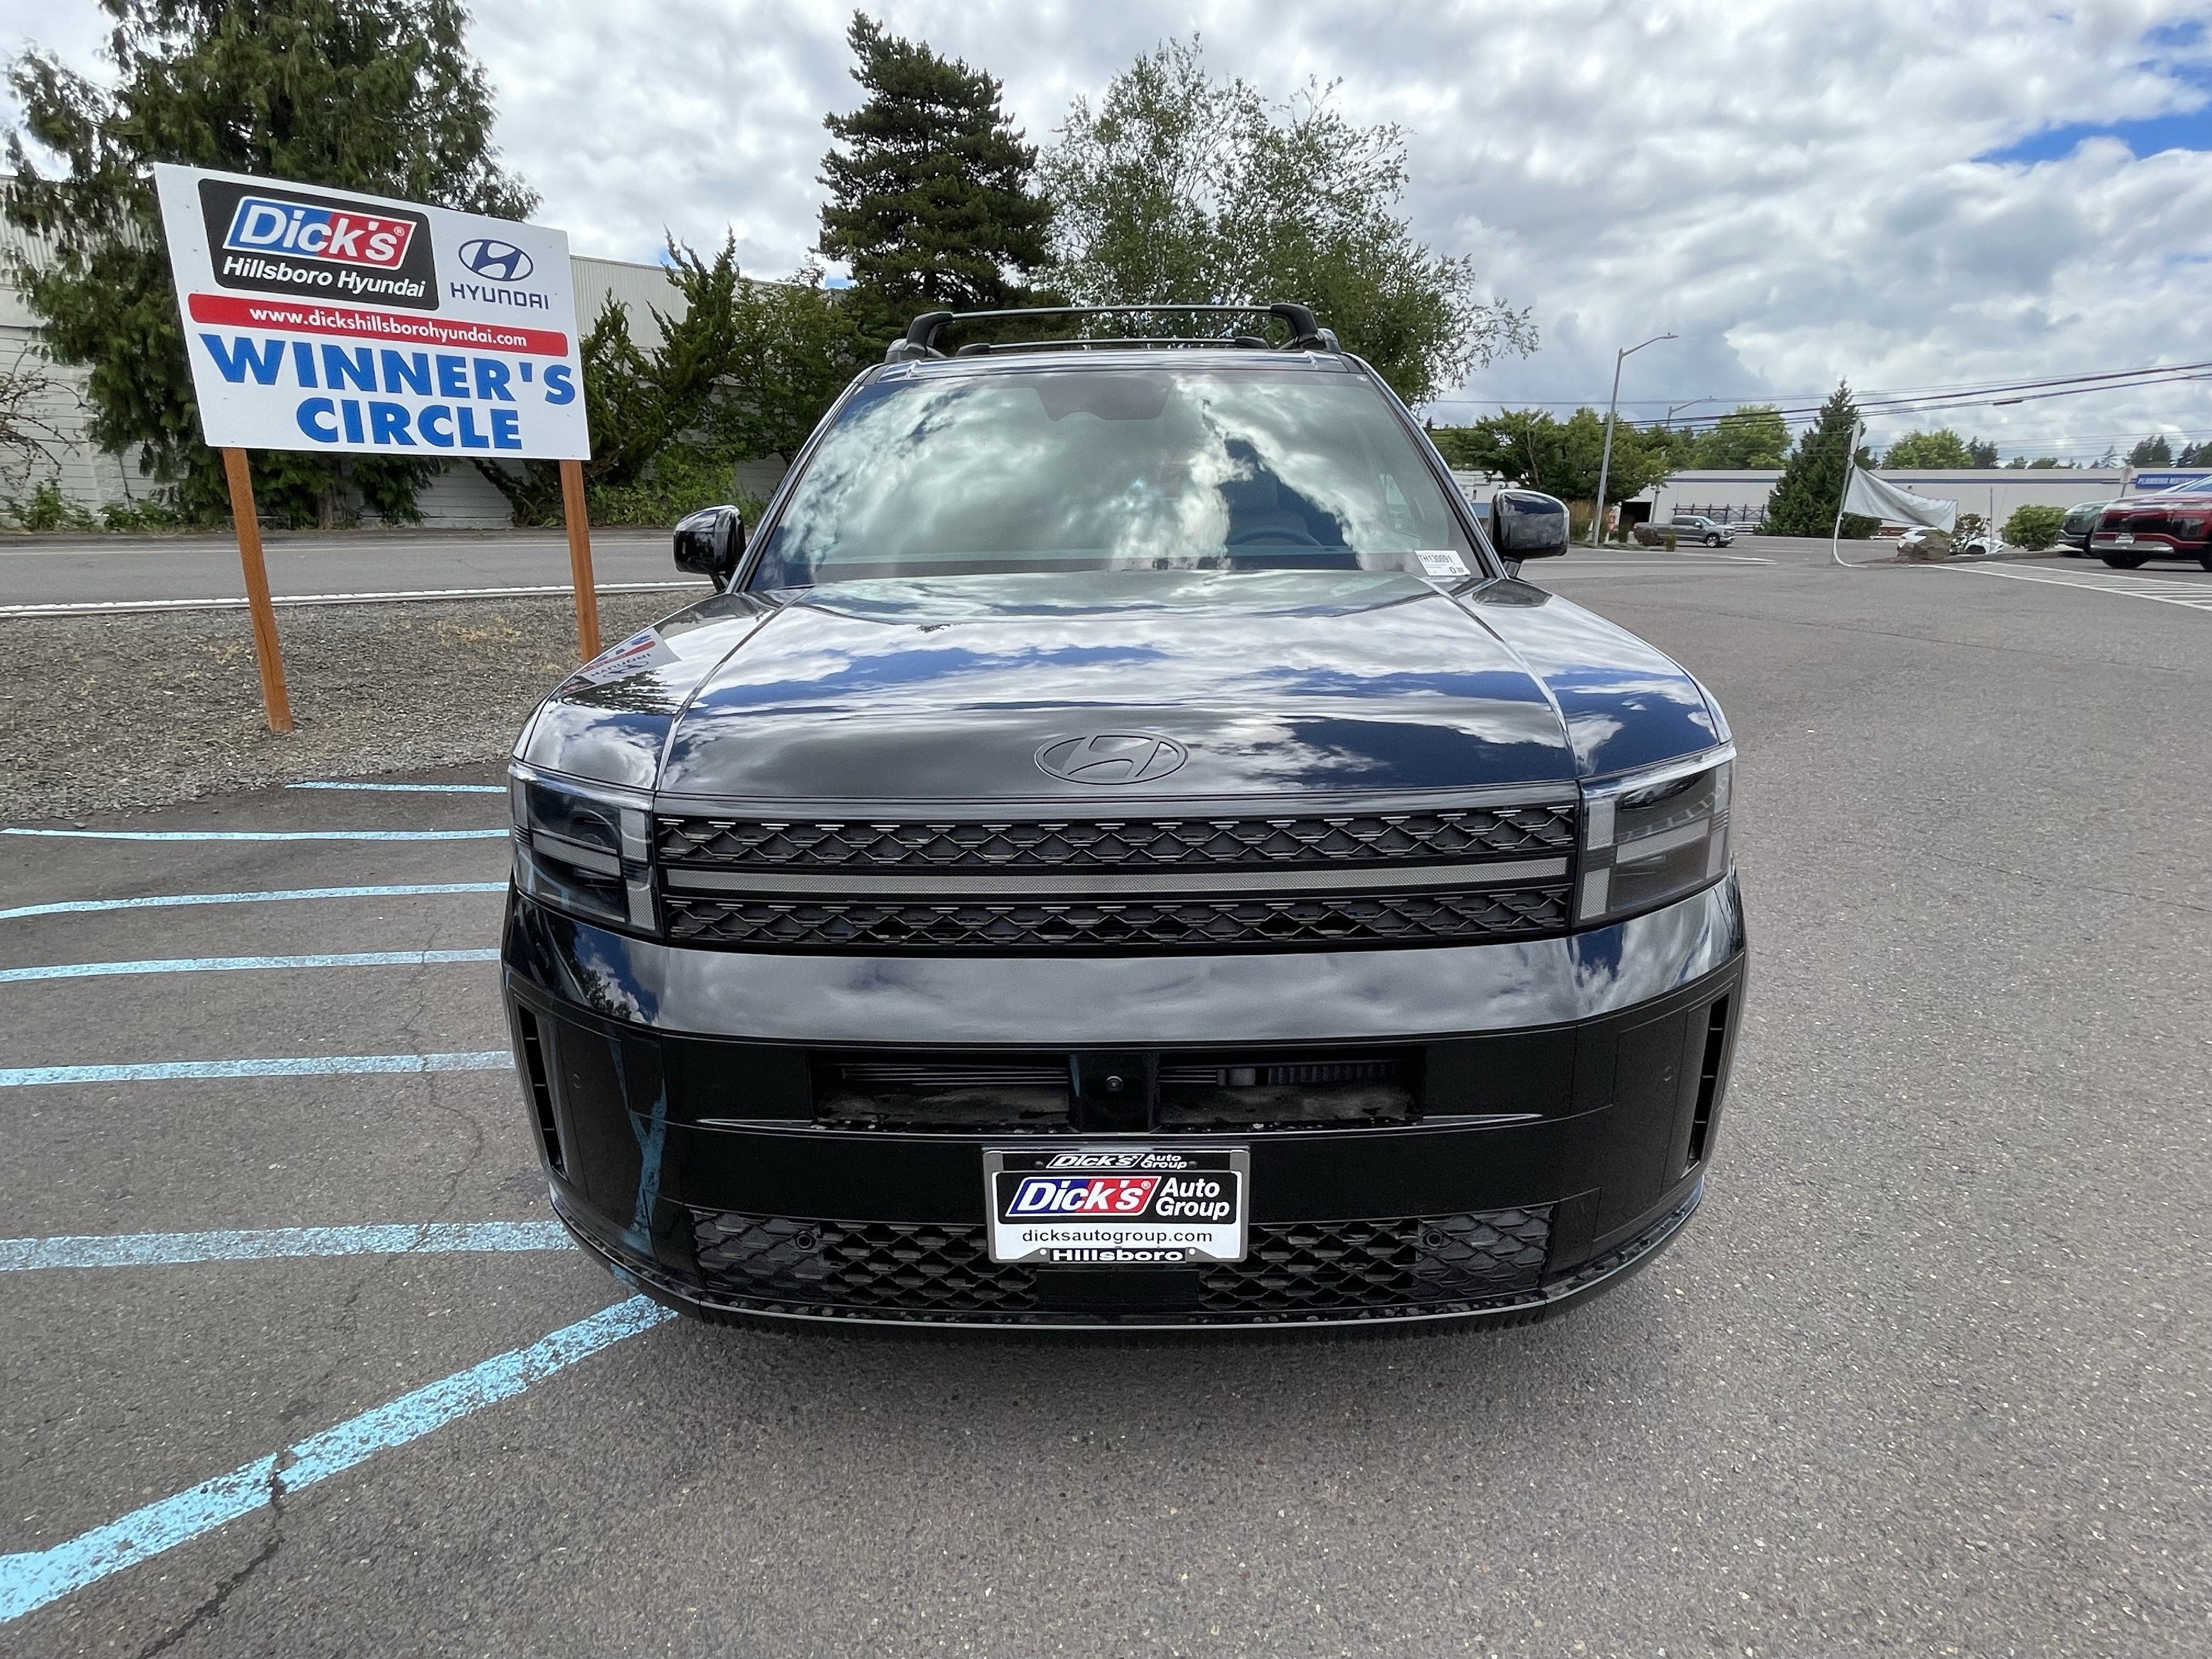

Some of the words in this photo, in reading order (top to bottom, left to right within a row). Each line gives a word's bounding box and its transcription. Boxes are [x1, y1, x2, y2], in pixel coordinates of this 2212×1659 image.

[239, 204, 398, 262] Dick's
[222, 256, 333, 286] Hillsboro
[338, 270, 426, 298] Hyundai
[450, 282, 549, 309] HYUNDAI
[249, 307, 527, 347] www.dickshillsborohyundai.com
[198, 333, 575, 406] WINNER'S
[296, 397, 522, 450] CIRCLE
[1140, 1160, 1188, 1170] Group
[1144, 1154, 1182, 1162] Auto
[1016, 1180, 1143, 1211] Dick's
[1159, 1177, 1220, 1198] Auto
[1155, 1197, 1230, 1221] Group
[1022, 1229, 1213, 1244] dicksautogroup.com
[1052, 1249, 1183, 1261] Hillsboro
